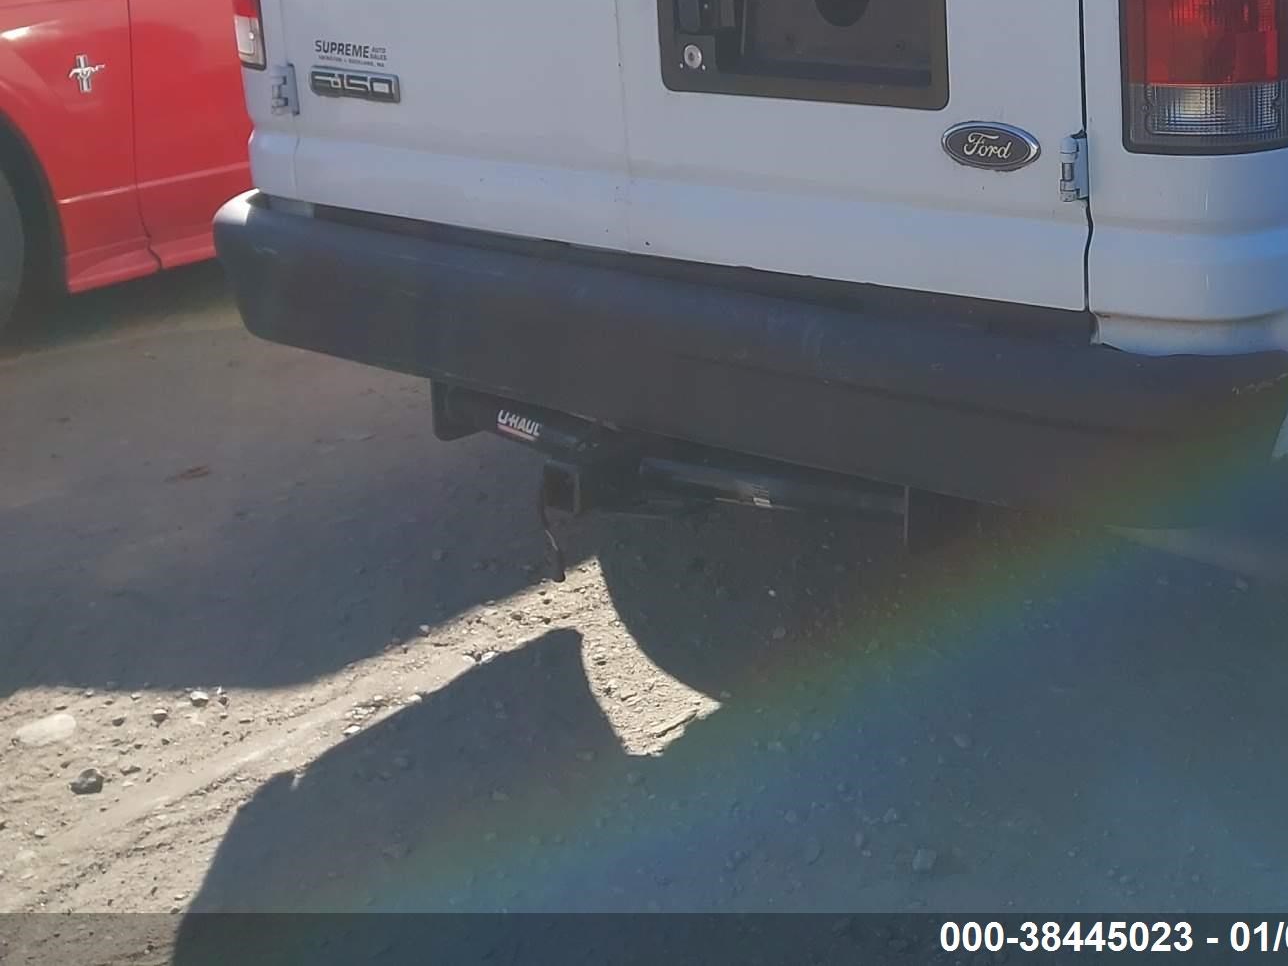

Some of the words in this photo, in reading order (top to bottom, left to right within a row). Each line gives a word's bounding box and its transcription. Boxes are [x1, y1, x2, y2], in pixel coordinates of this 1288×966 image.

[315, 40, 370, 59] SUPREME
[963, 132, 1012, 159] Ford
[497, 409, 541, 436] U-HAUL
